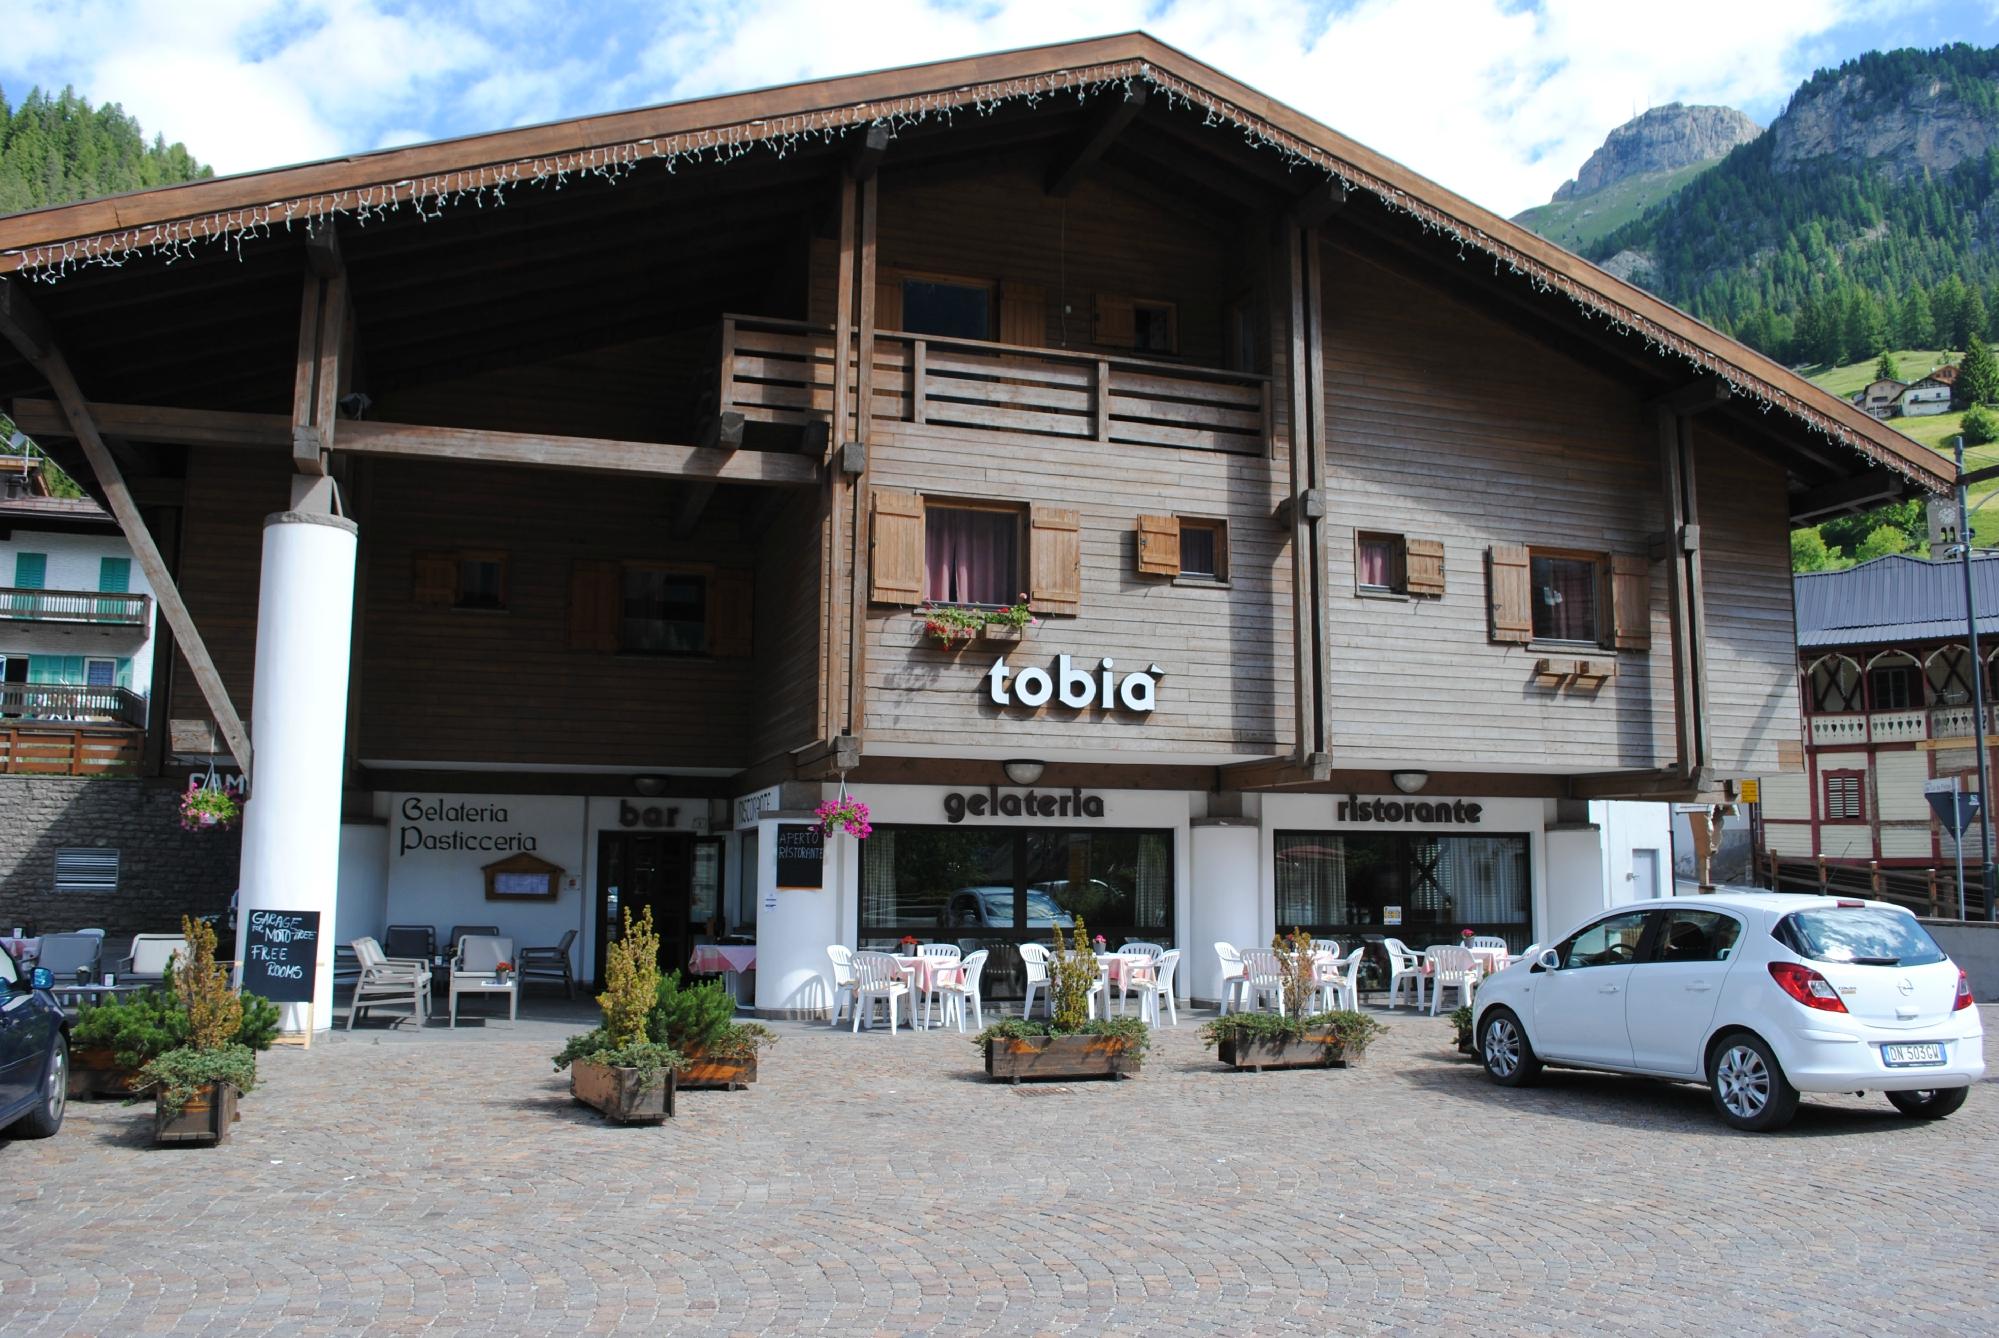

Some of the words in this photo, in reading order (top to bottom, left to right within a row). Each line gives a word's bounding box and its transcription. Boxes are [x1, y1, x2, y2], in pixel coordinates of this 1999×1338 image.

[402, 797, 508, 822] Gelateria
[944, 784, 1104, 823] gelateria
[1337, 793, 1483, 823] ristorante
[619, 799, 680, 828] bar
[400, 826, 537, 856] Pasticceria
[779, 831, 819, 845] APERTO
[778, 846, 824, 860] RISTORANTE
[251, 911, 303, 930] GARAGE
[264, 927, 292, 944] MOTO
[251, 944, 288, 960] FREE
[266, 961, 303, 979] ROOMS
[1889, 1046, 1905, 1061] DN
[1908, 1045, 1940, 1061] 503GW
